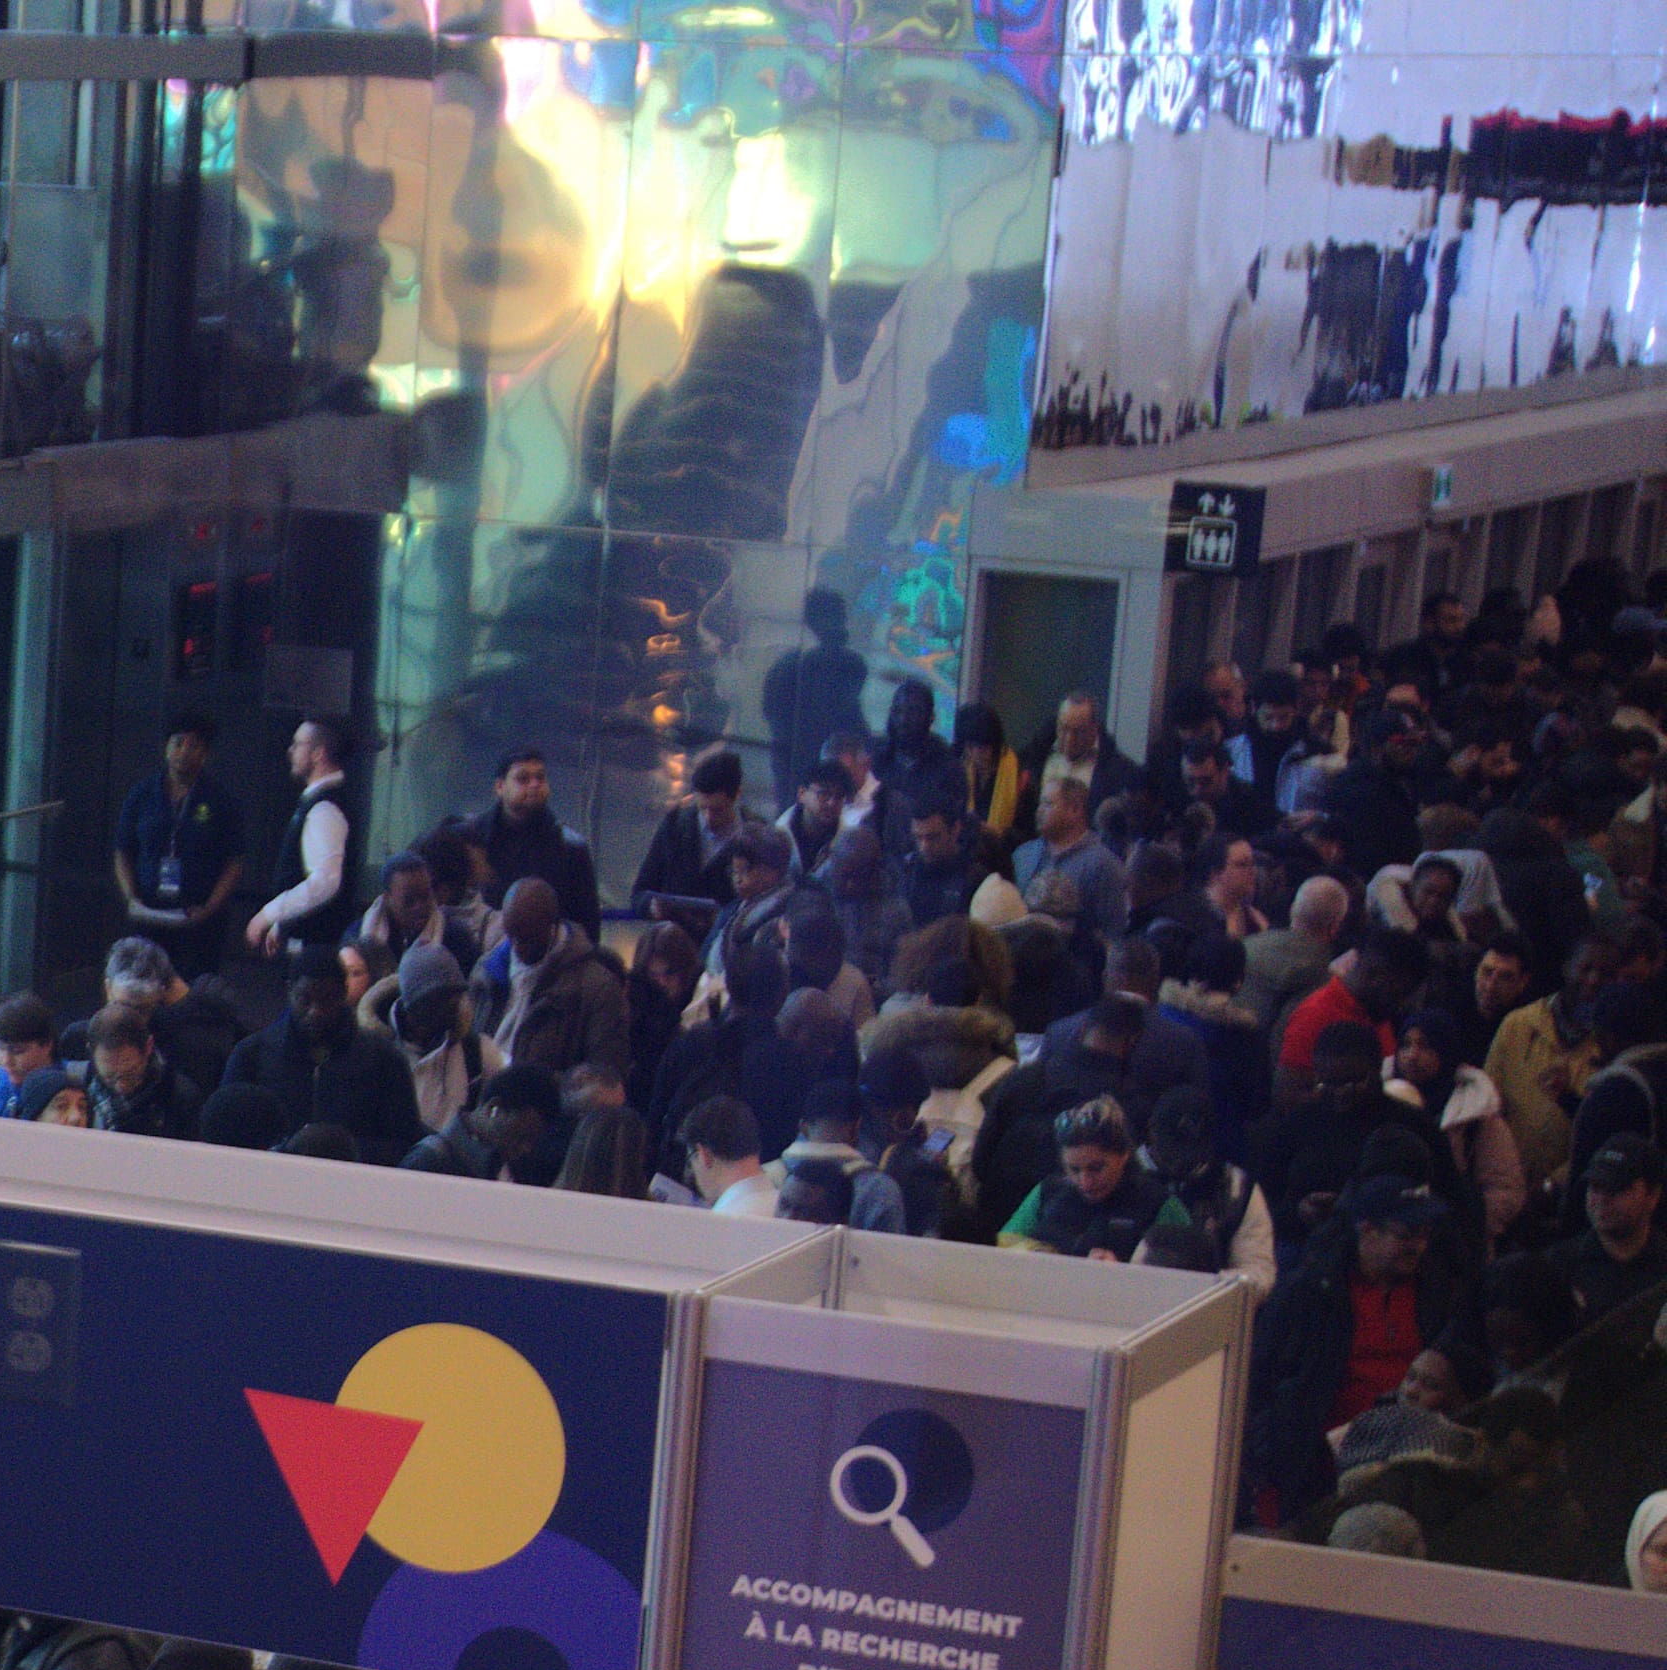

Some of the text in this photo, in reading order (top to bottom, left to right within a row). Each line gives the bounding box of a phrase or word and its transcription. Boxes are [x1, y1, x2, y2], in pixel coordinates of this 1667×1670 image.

[731, 1574, 1023, 1638] ACCOMPAGNEMENT
[744, 1610, 766, 1640] À
[775, 1620, 814, 1647] LA
